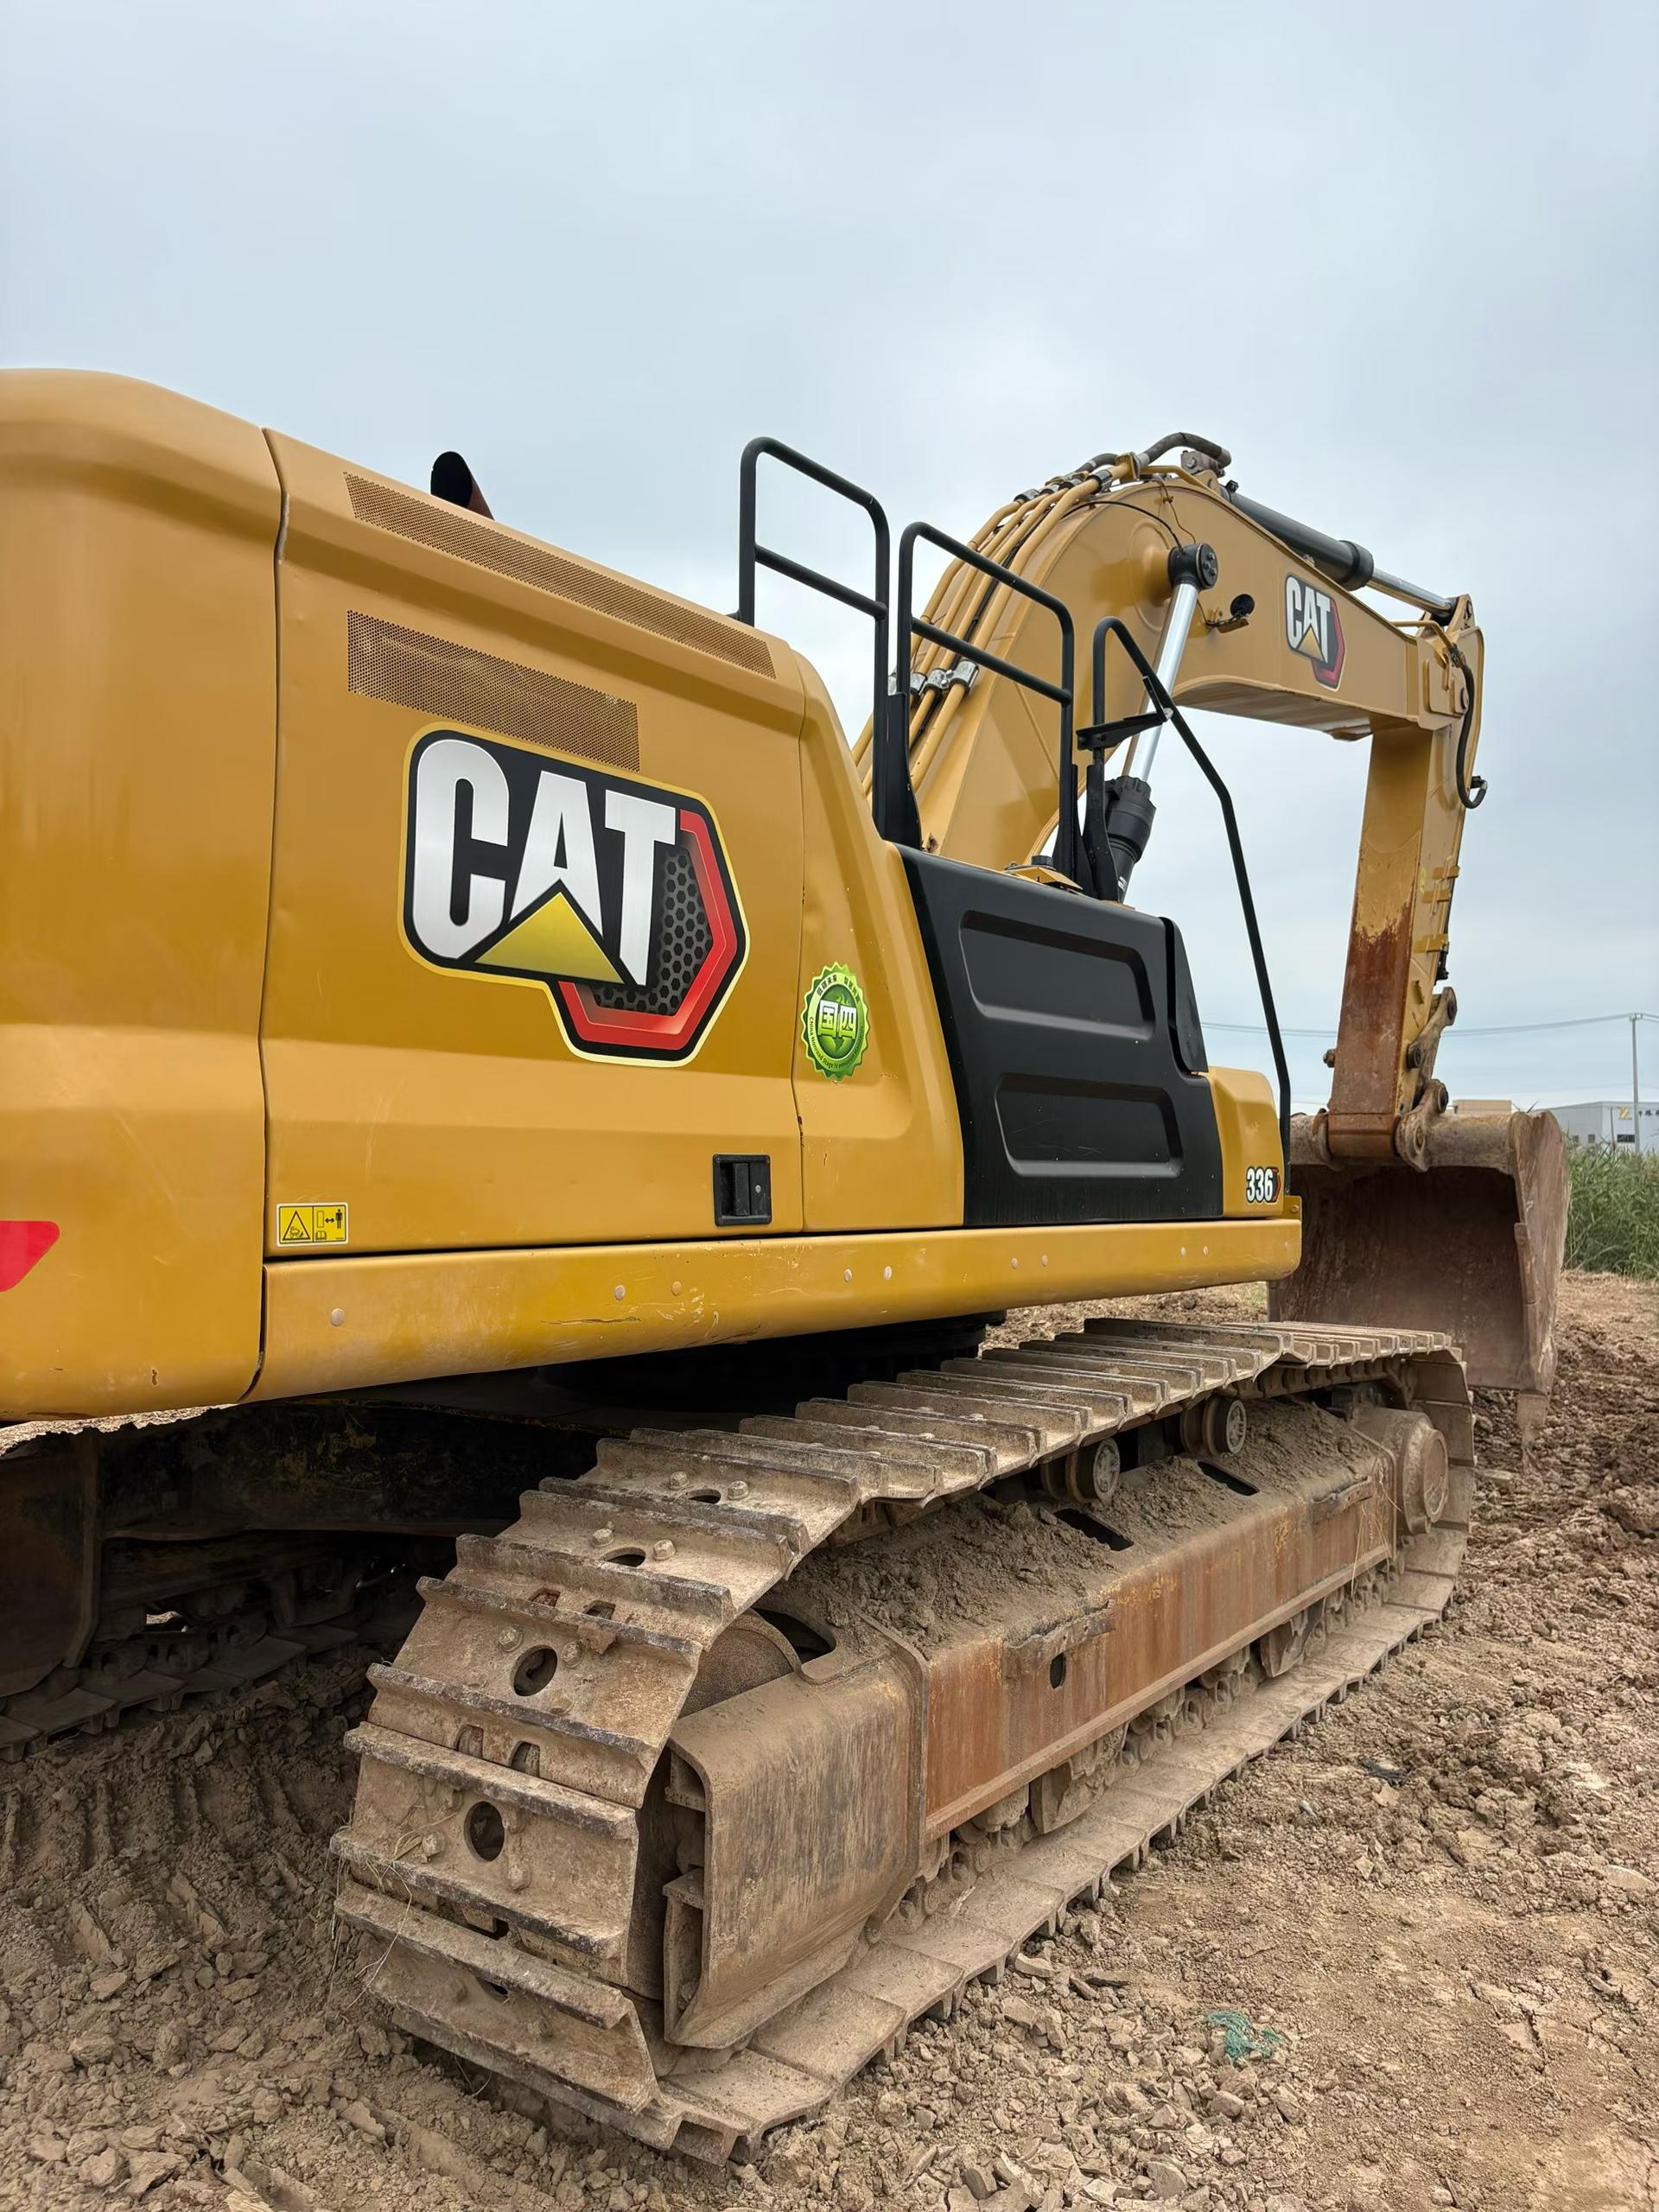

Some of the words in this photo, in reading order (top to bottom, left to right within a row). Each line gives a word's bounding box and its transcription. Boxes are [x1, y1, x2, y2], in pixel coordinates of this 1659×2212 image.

[1286, 576, 1331, 664] CAT
[412, 739, 676, 986] CAT
[817, 1000, 857, 1039] 国四
[1247, 1167, 1274, 1201] 336
